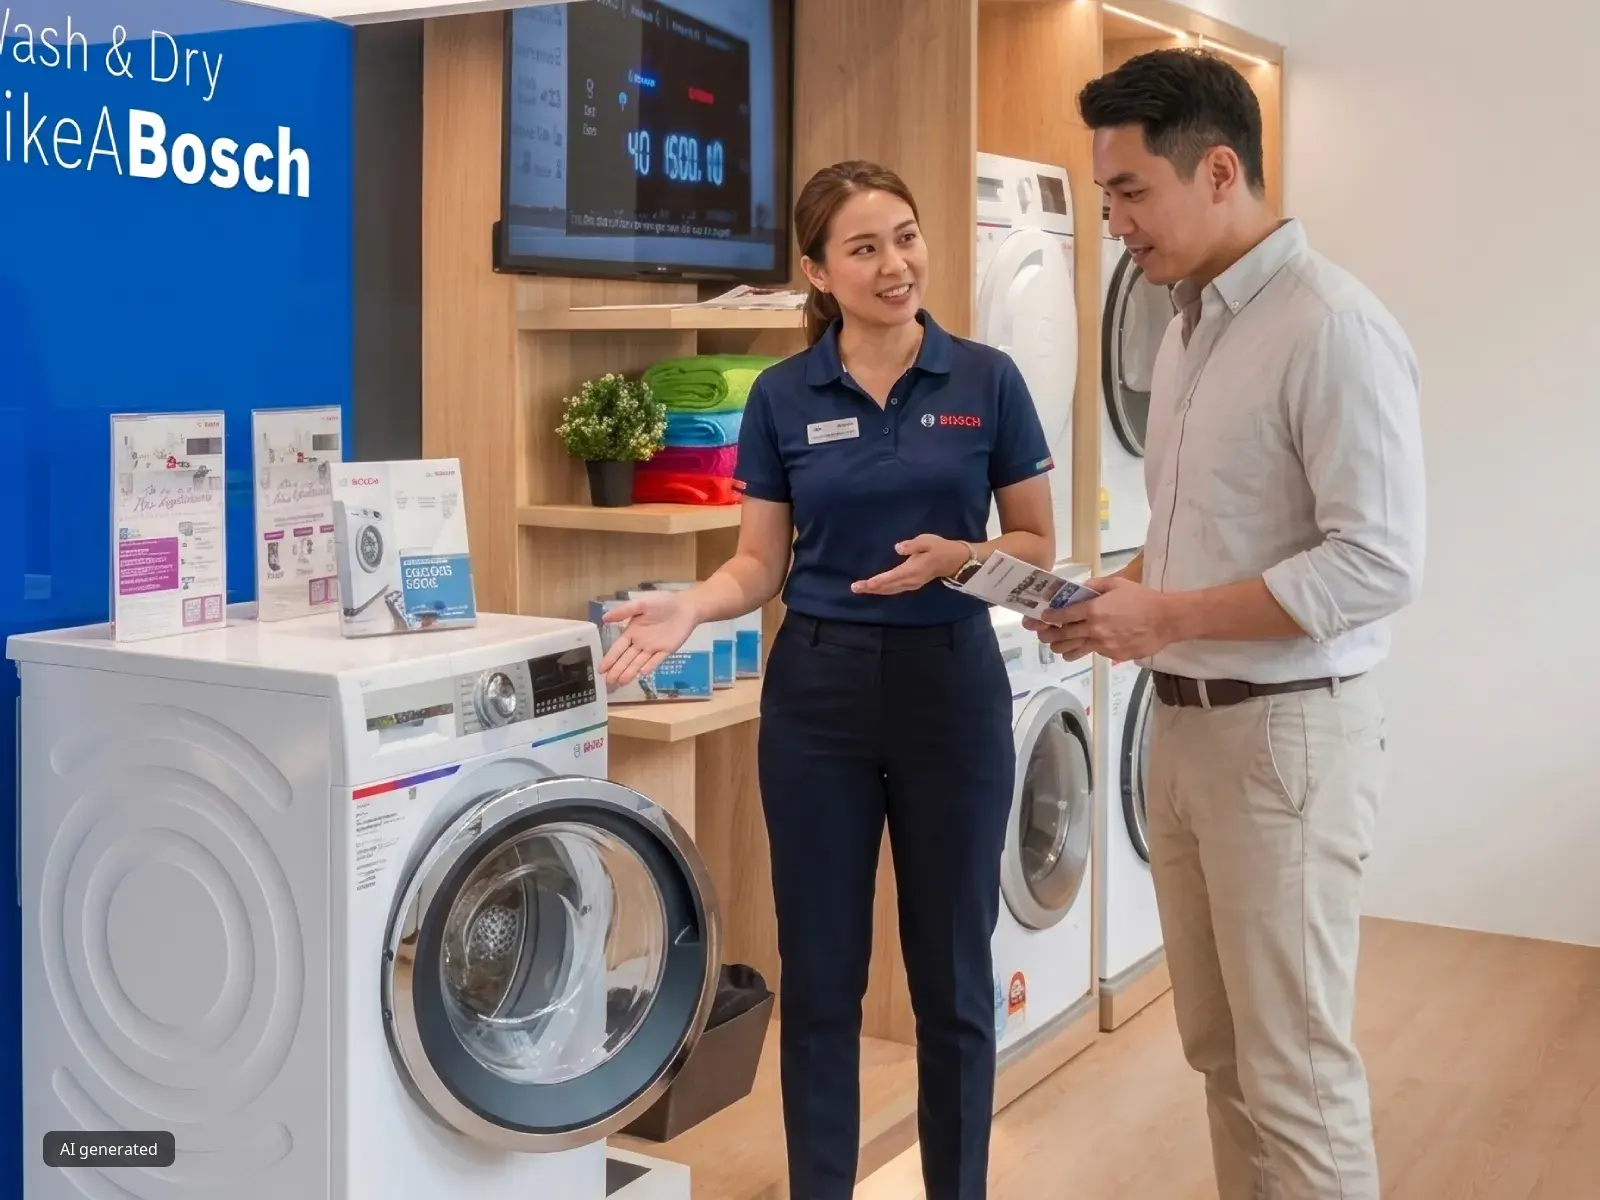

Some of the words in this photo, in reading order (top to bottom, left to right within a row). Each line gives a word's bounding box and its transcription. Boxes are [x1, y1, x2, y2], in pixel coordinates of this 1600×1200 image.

[0, 8, 88, 72] ash
[105, 25, 133, 79] &
[151, 30, 223, 102] Dry
[627, 130, 651, 176] 40
